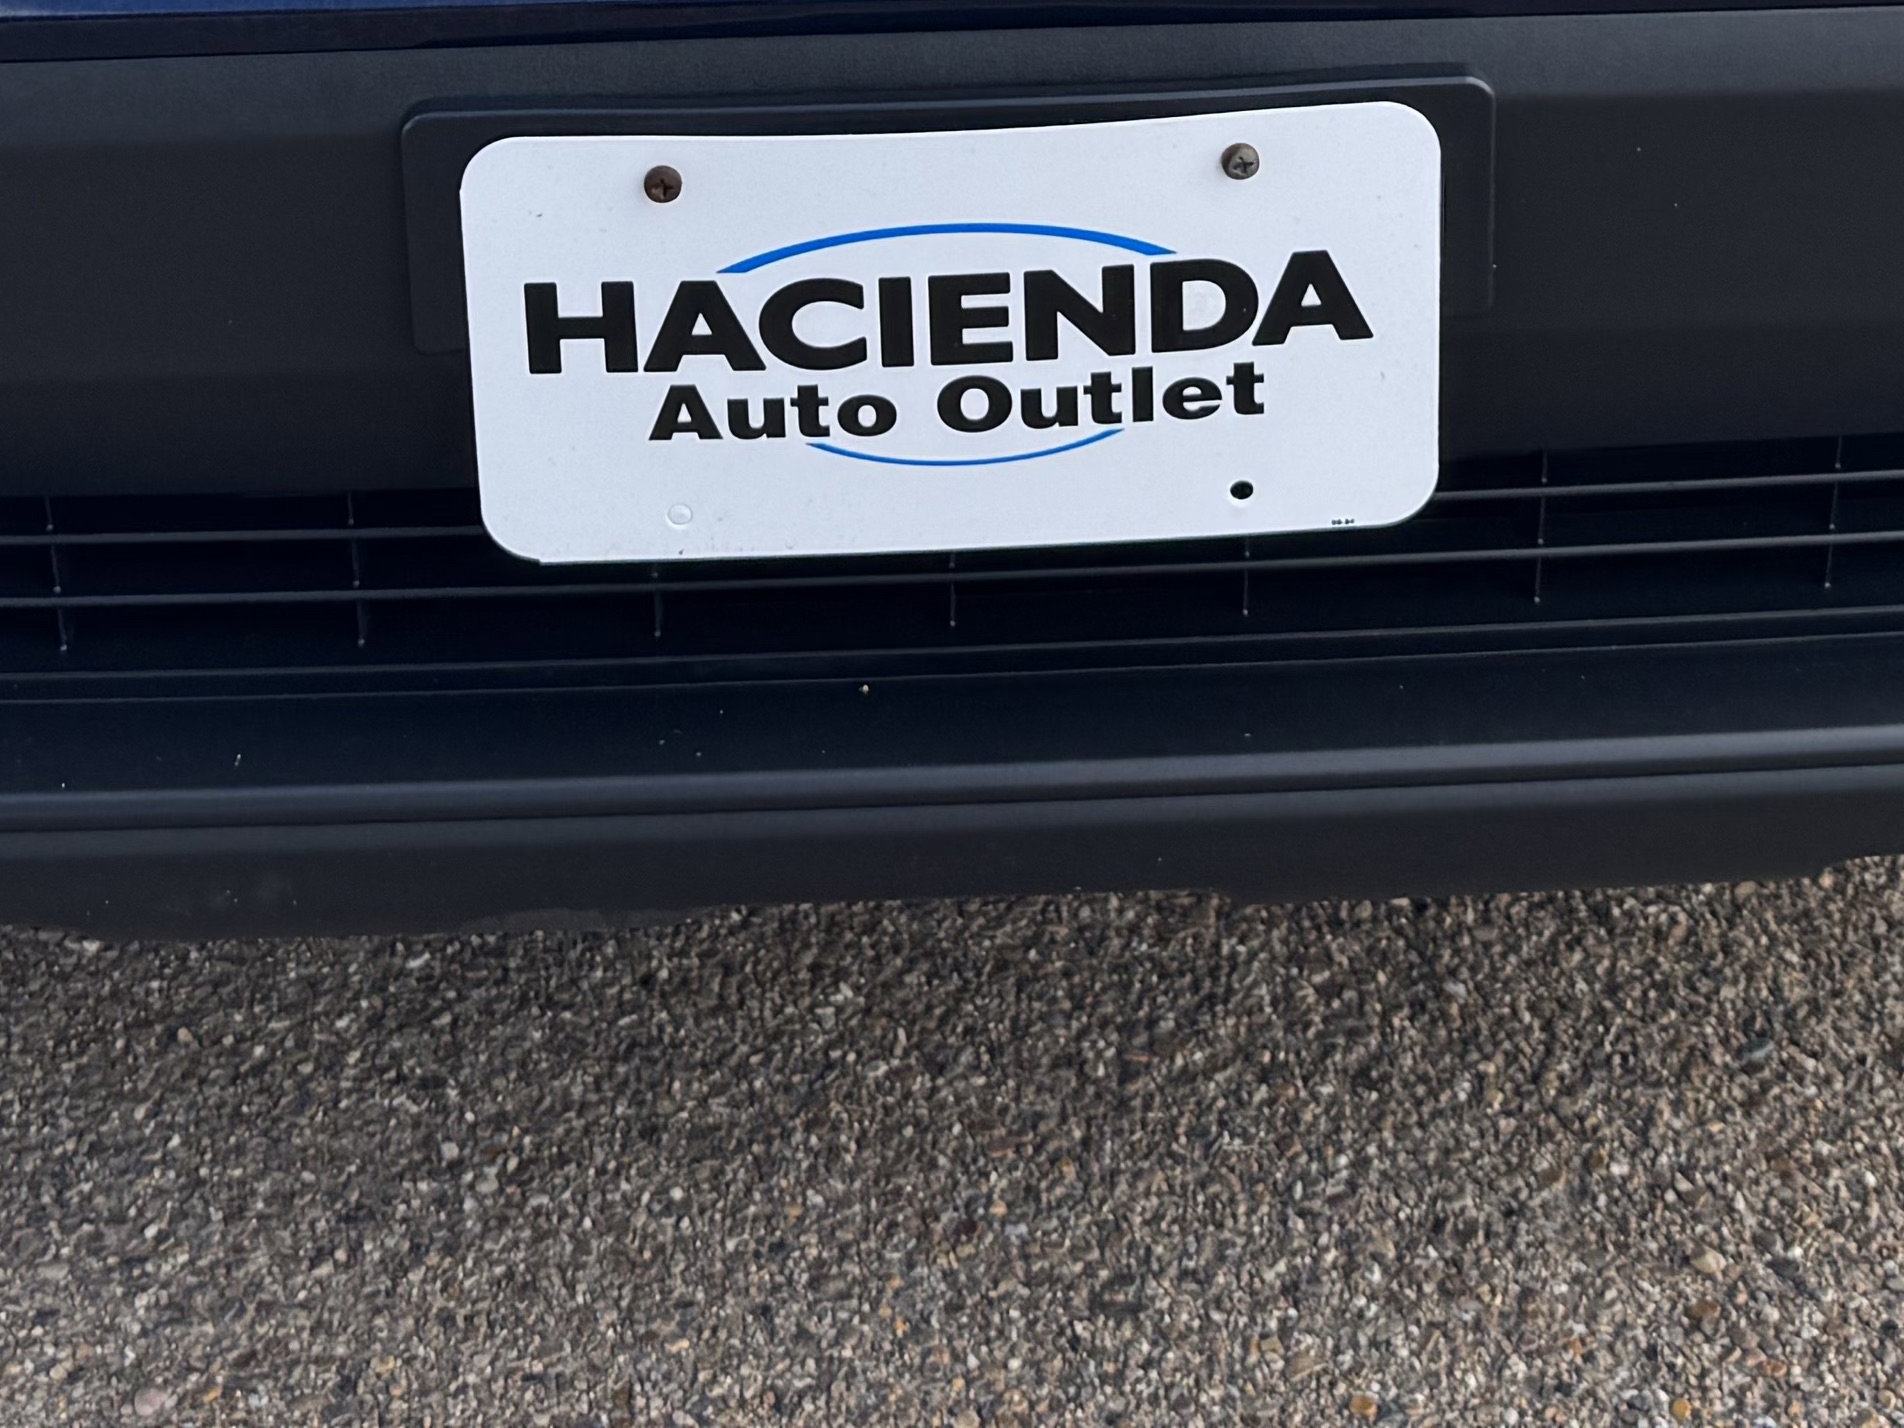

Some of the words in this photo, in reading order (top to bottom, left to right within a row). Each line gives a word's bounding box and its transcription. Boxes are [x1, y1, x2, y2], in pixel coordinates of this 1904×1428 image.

[524, 250, 1374, 375] HACIENDA
[648, 384, 897, 441] Auto
[936, 361, 1265, 433] Outlet
